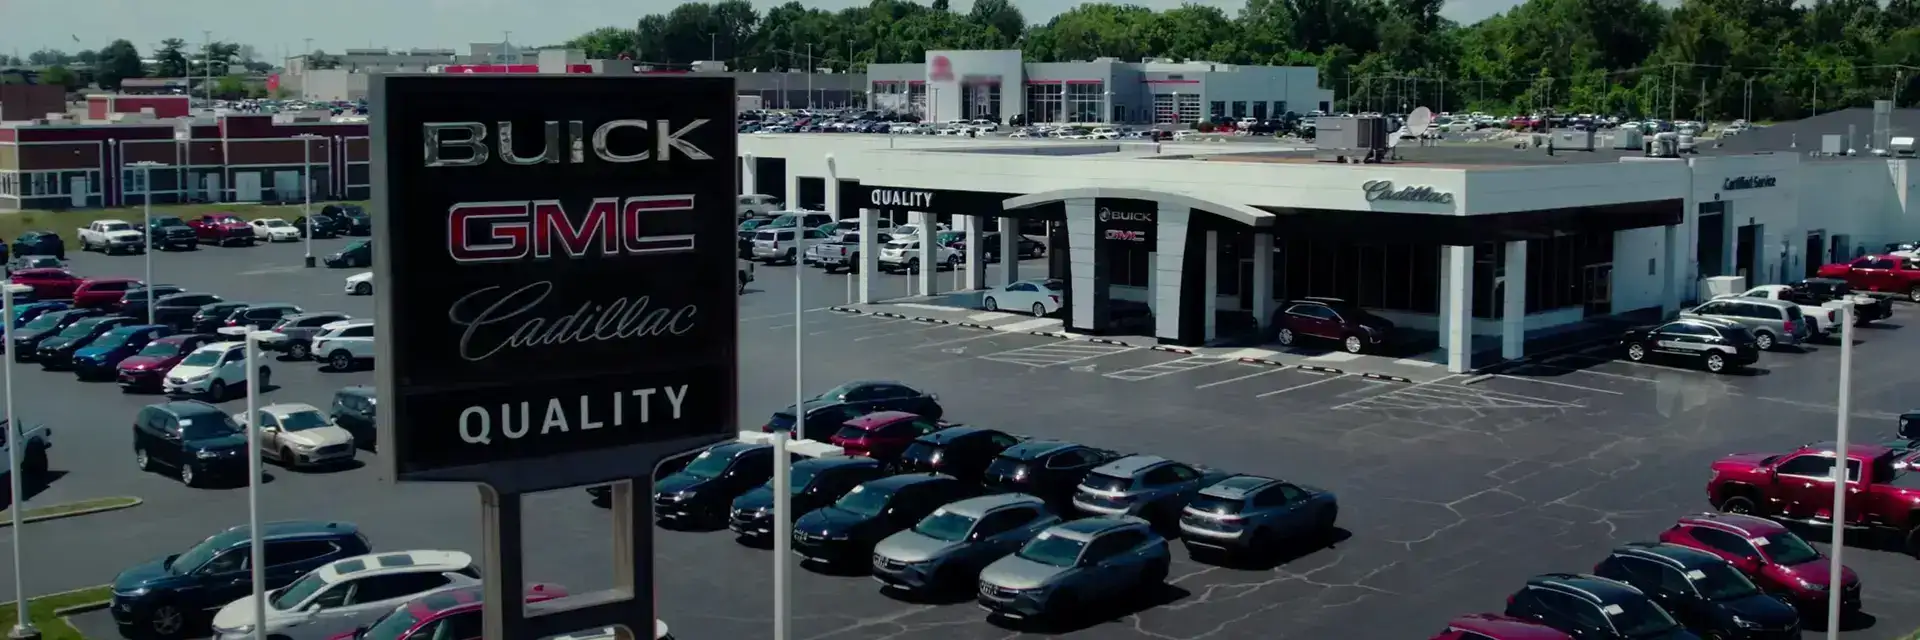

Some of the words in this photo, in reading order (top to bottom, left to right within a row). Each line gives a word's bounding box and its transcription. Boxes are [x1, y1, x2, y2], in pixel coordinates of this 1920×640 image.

[423, 119, 713, 167] BUICK
[871, 189, 932, 207] QUALITY
[1362, 180, 1453, 204] Cadillac
[448, 194, 696, 262] GMC
[1111, 211, 1152, 222] BUICK
[1105, 229, 1145, 242] GMC
[448, 280, 697, 361] Cadillac
[458, 384, 688, 445] QUALITY
